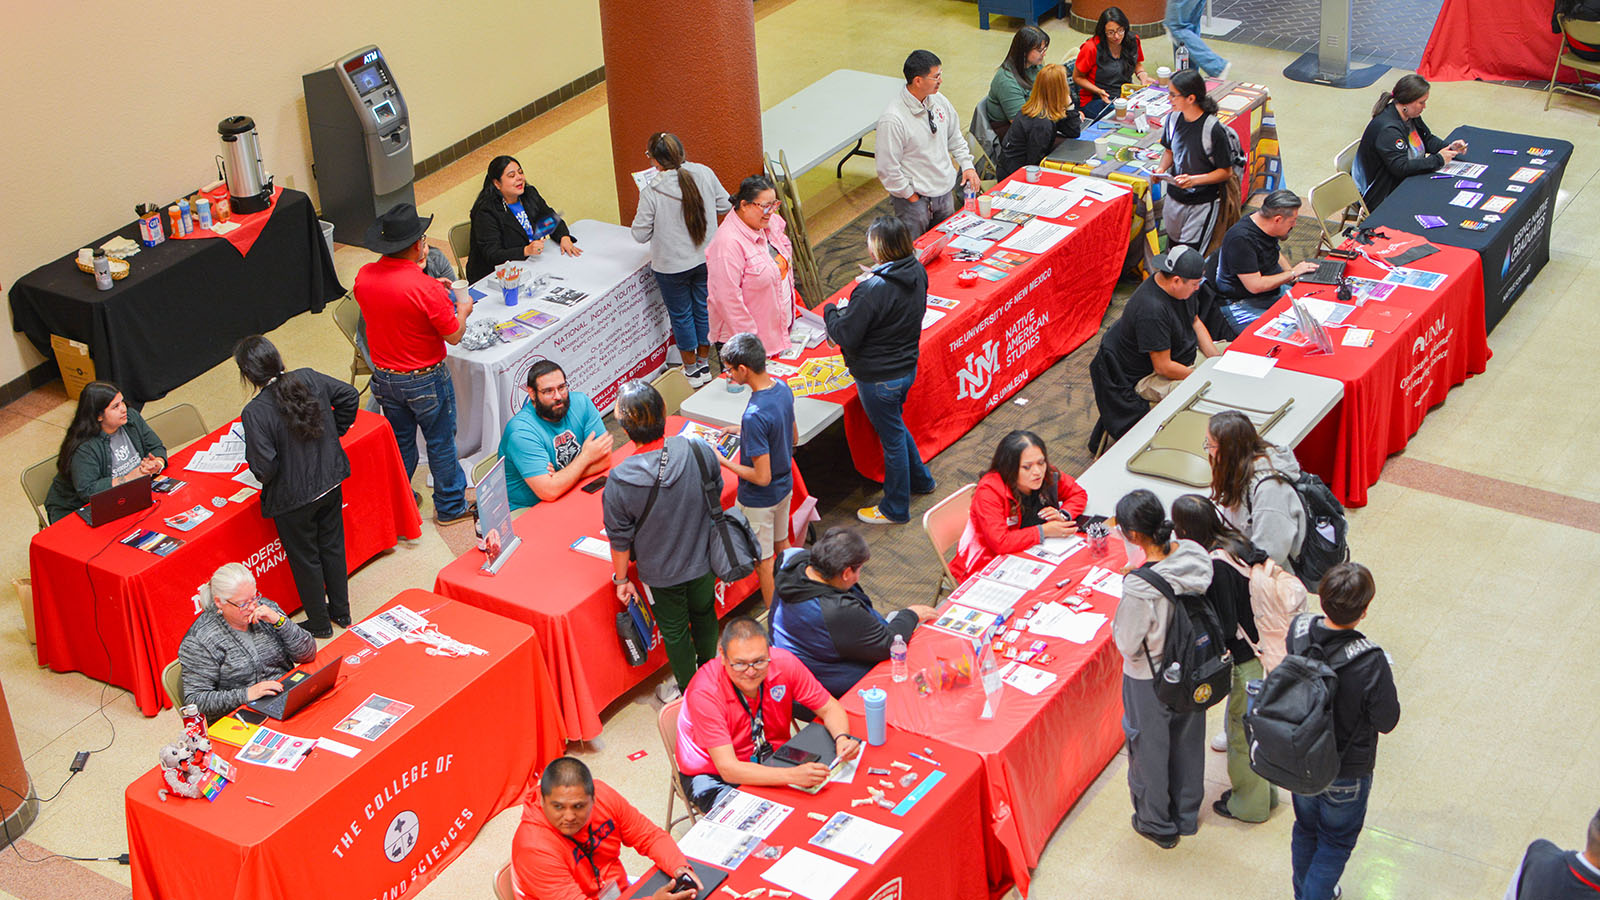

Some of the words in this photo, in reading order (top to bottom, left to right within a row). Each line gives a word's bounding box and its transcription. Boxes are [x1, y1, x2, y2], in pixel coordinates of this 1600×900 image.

[363, 50, 378, 64] ATM
[553, 321, 588, 348] NATIONAL
[590, 301, 612, 322] INDIAN
[614, 282, 637, 302] YOUTH
[639, 268, 656, 284] COU
[949, 337, 964, 353] THE
[964, 307, 1004, 342] UNIVERSITY
[1004, 298, 1014, 312] OF
[1014, 285, 1029, 304] NEW
[1029, 267, 1052, 292] MEXICO
[1005, 308, 1036, 342] NATIVE
[560, 324, 595, 353] WORKFORCE
[1006, 311, 1050, 355] AMERICAN
[1006, 331, 1040, 368] STUDIES
[594, 384, 617, 404] GALLUP,
[242, 538, 282, 569] NDERS
[332, 820, 362, 858] THE
[364, 760, 428, 820] COLLEGE
[436, 754, 454, 774] OF
[382, 880, 408, 900] AND
[410, 808, 474, 881] SCIENCES
